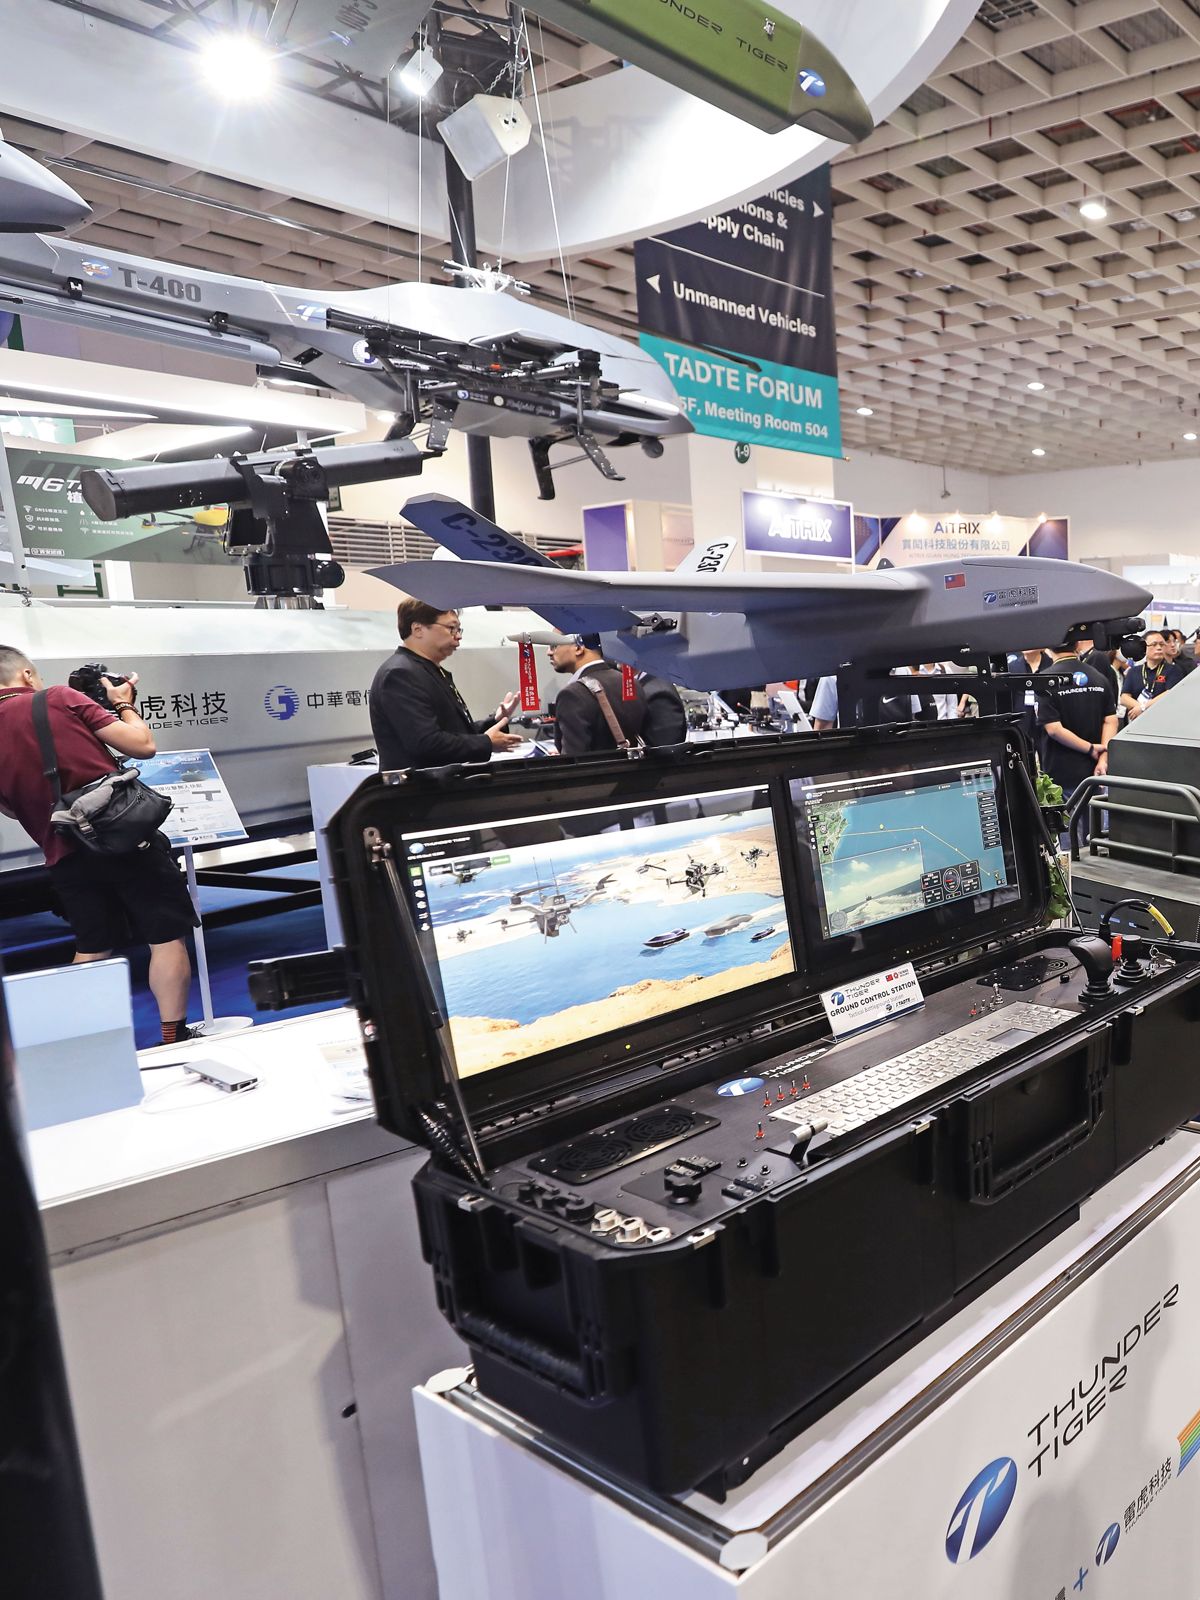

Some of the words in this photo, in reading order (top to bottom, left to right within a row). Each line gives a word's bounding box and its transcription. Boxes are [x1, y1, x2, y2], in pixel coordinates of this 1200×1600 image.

[735, 37, 789, 73] TIGER
[743, 223, 785, 252] Chain
[776, 212, 788, 230] &
[117, 266, 202, 303] T-400
[672, 280, 755, 324] Unmanned
[758, 306, 817, 339] Vehicles
[663, 352, 741, 392] TADTE
[745, 372, 823, 409] FORUM
[704, 401, 761, 429] Meeting
[764, 413, 802, 433] Room
[805, 421, 829, 439] 504
[185, 716, 229, 726] TIGER
[830, 1001, 860, 1018] GROUND
[860, 991, 890, 1009] CONTROL
[891, 980, 917, 995] STATION
[844, 978, 880, 995] THUNDER
[846, 988, 869, 1001] TIGER
[760, 1047, 828, 1076] THUNDER
[769, 1059, 814, 1079] TIGER
[1027, 1284, 1180, 1446] THUNDER
[1027, 1365, 1129, 1478] TIGER
[1123, 1456, 1172, 1529] 雷虎科技
